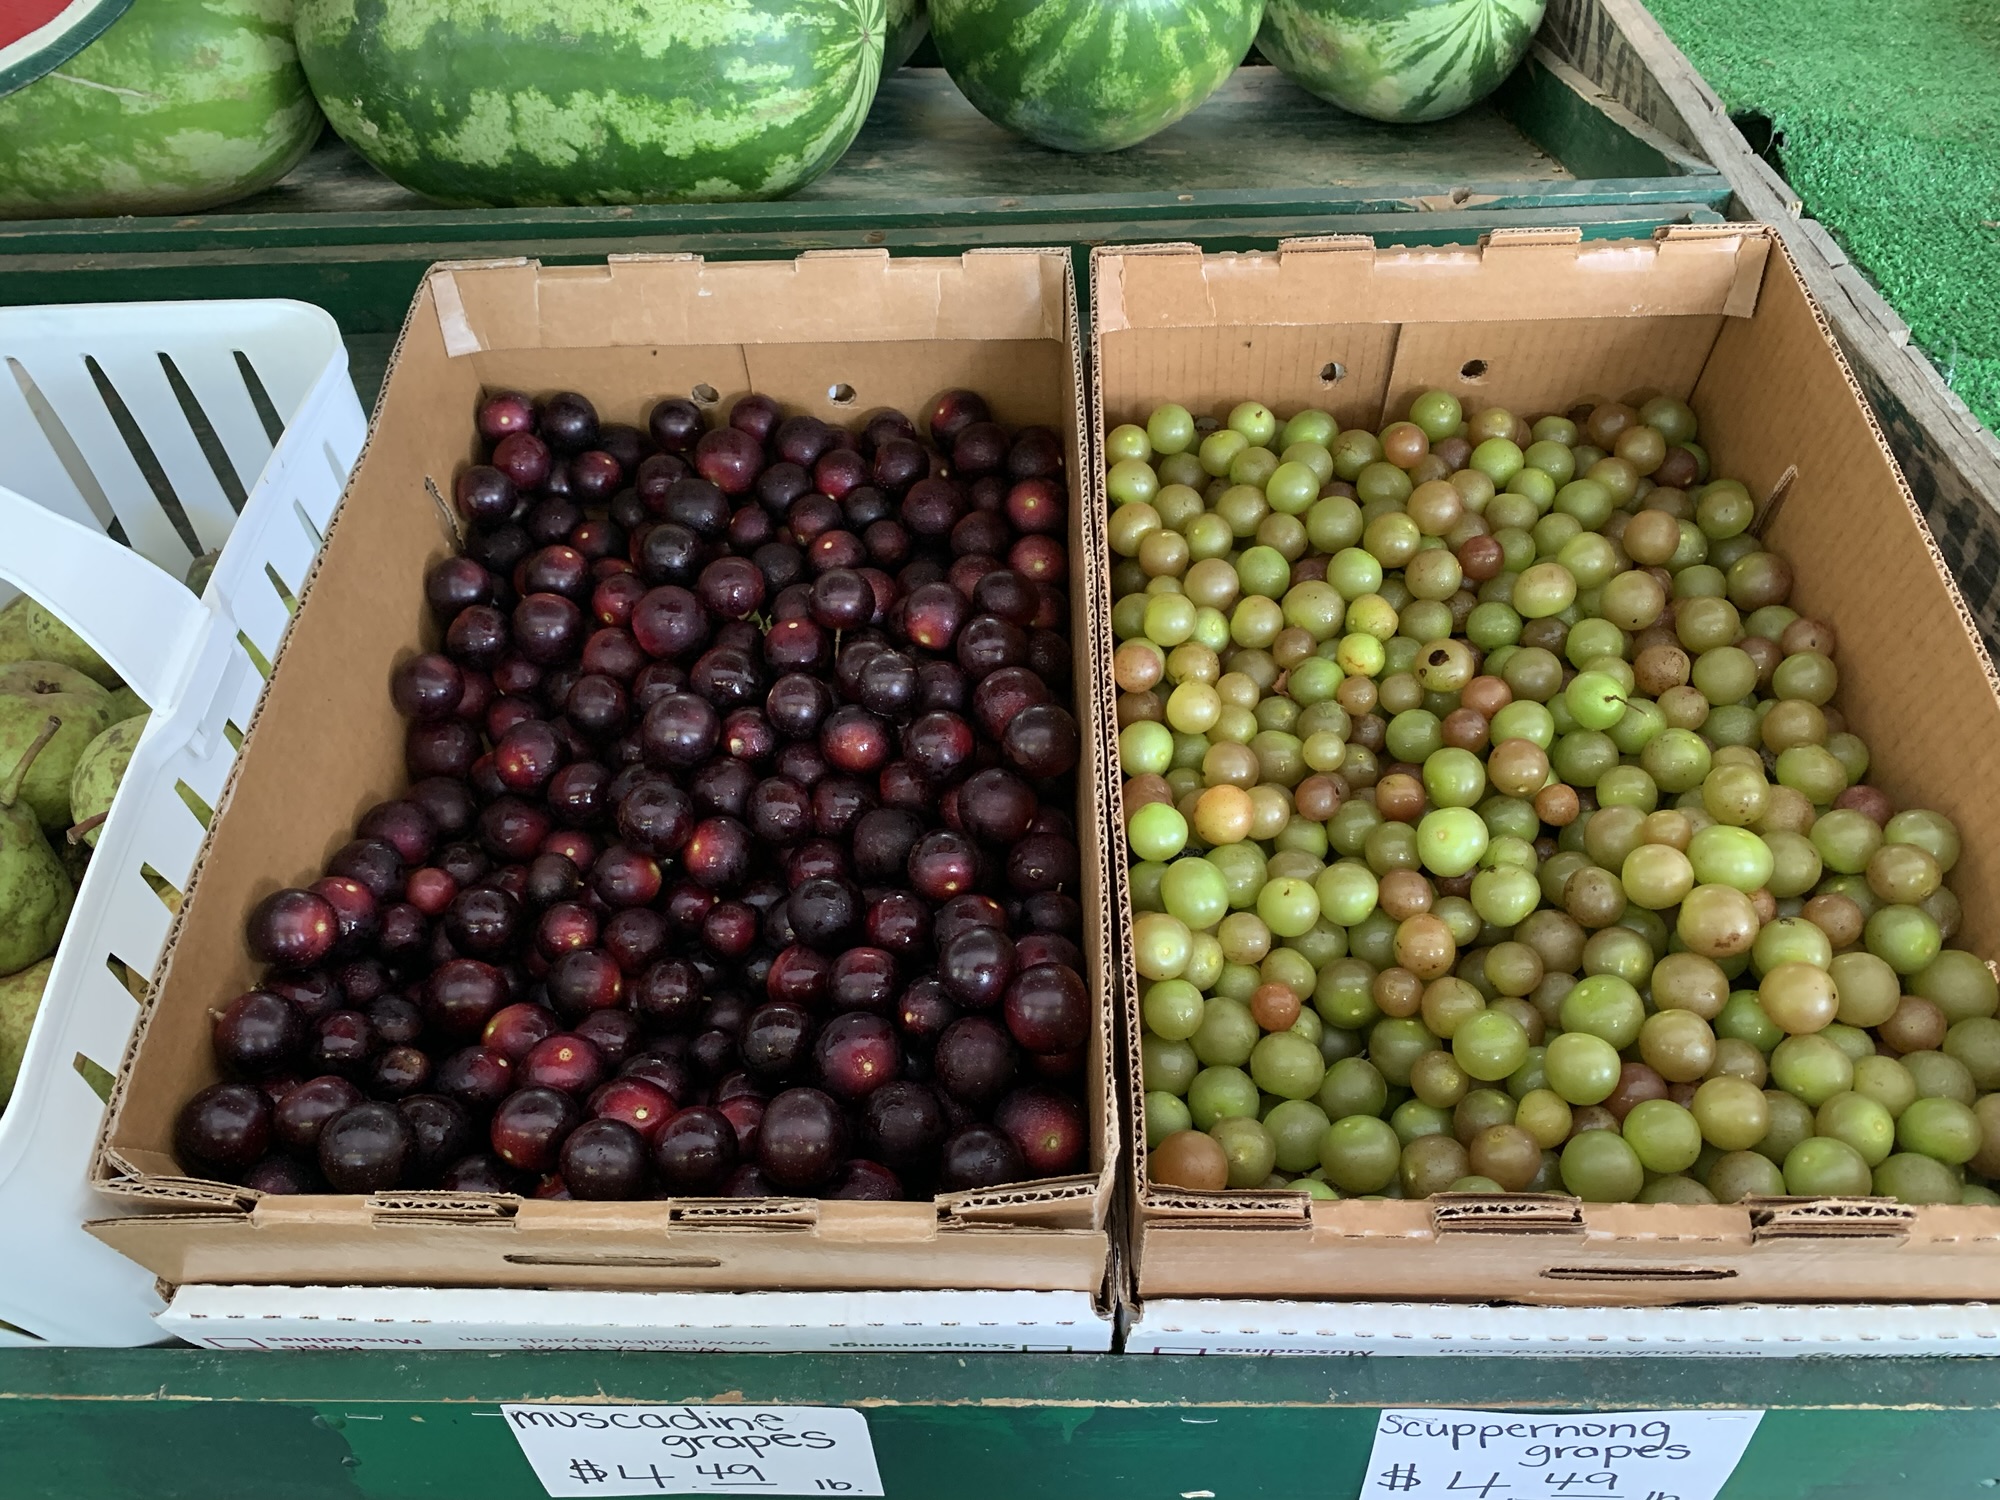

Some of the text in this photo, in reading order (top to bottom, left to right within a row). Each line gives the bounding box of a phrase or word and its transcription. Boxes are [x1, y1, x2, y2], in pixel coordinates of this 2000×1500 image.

[265, 1337, 423, 1345] Muscadines
[457, 1336, 771, 1346] www.paulkvineyards.com
[828, 1341, 1017, 1350] Scuppernongs
[1215, 1347, 1375, 1357] Muscadines
[511, 1407, 785, 1431] muscadine
[1380, 1414, 1671, 1451] Scuppernong
[661, 1430, 836, 1459] grapes
[1518, 1444, 1691, 1468] grapes
